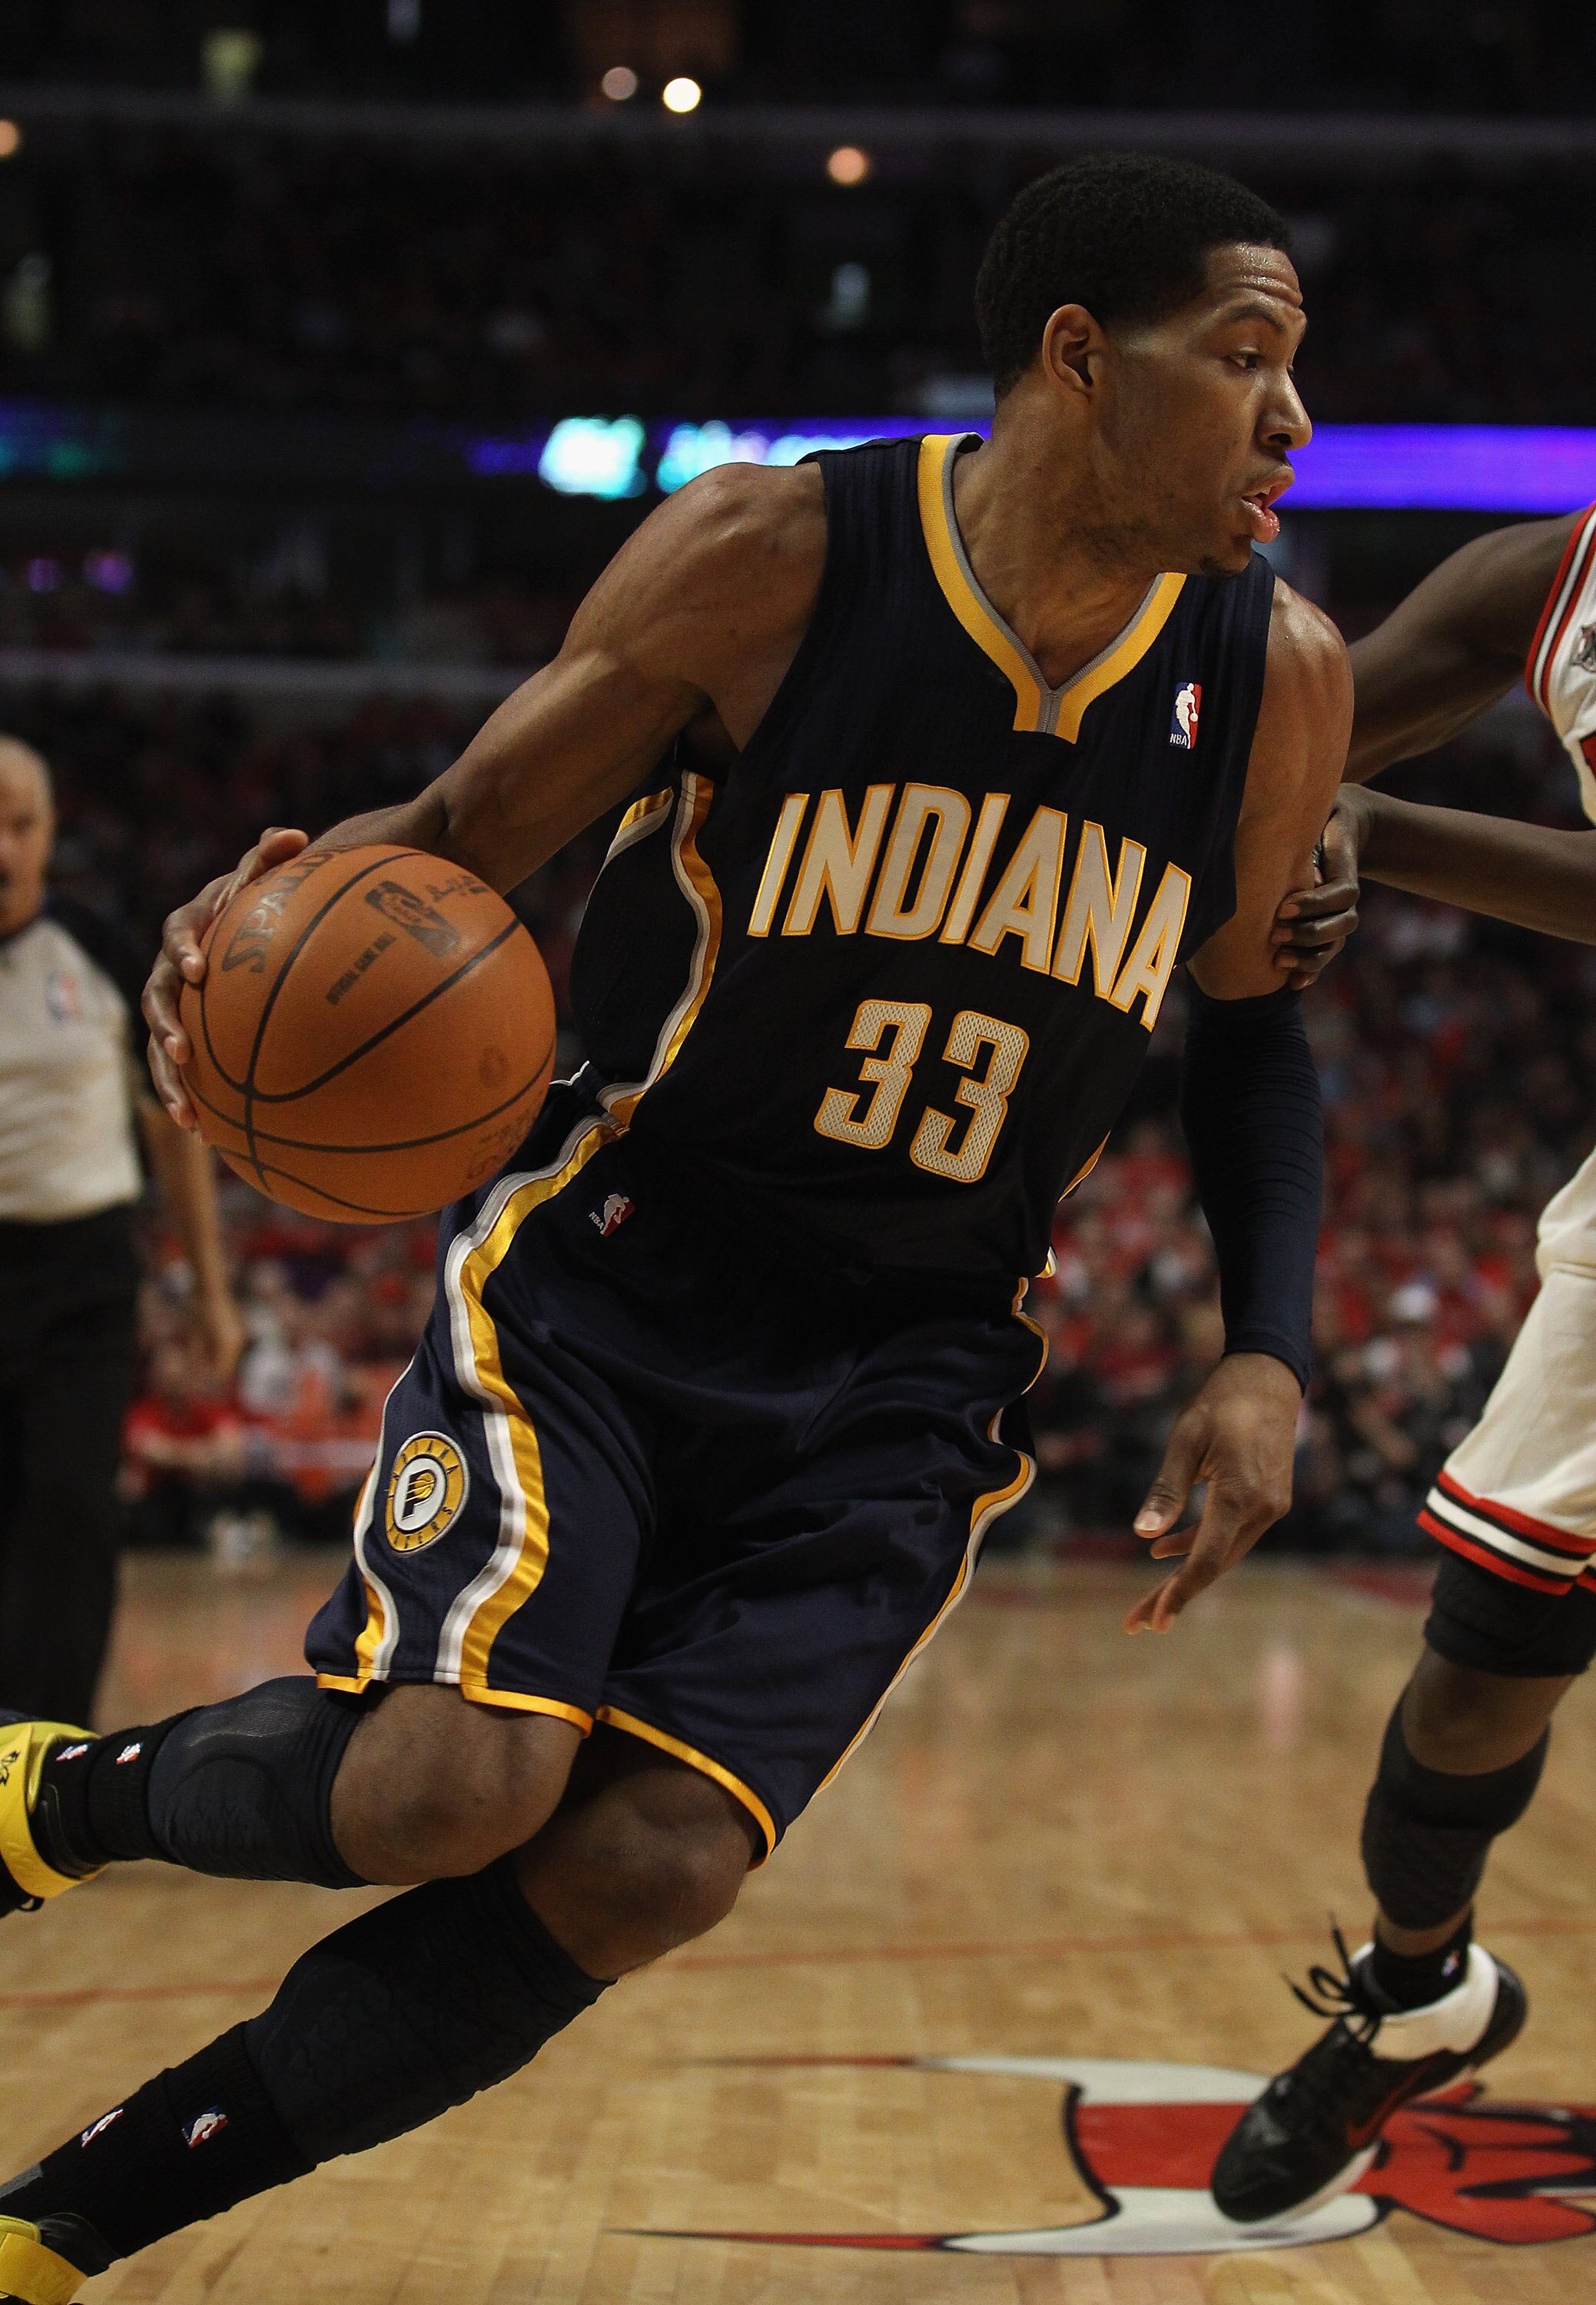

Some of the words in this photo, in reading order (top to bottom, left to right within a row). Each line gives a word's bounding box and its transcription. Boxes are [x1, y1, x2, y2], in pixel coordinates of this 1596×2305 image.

[1170, 733, 1187, 746] NBA
[747, 782, 1192, 1033] INDIANA
[814, 1000, 1030, 1182] 33
[589, 1212, 605, 1229] NBA
